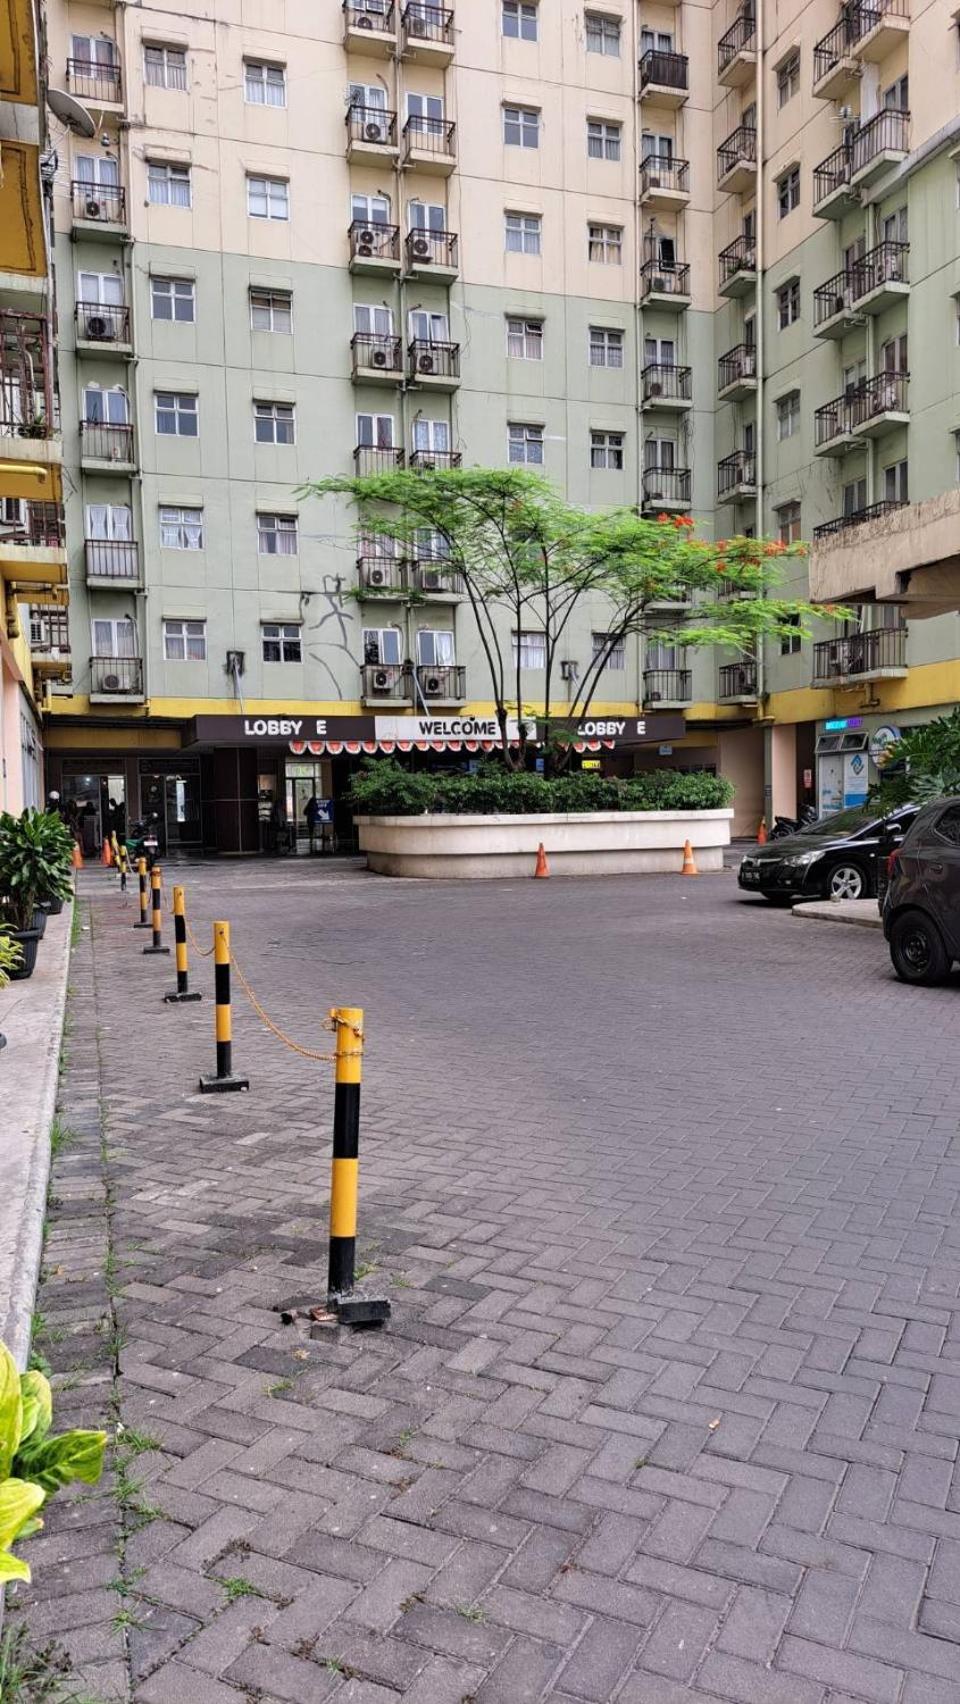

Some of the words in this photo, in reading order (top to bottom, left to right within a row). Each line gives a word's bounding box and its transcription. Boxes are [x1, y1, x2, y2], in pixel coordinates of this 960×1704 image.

[244, 720, 303, 736] LOBBY
[316, 720, 327, 735] E
[418, 721, 497, 735] WELCOME
[637, 721, 647, 735] E
